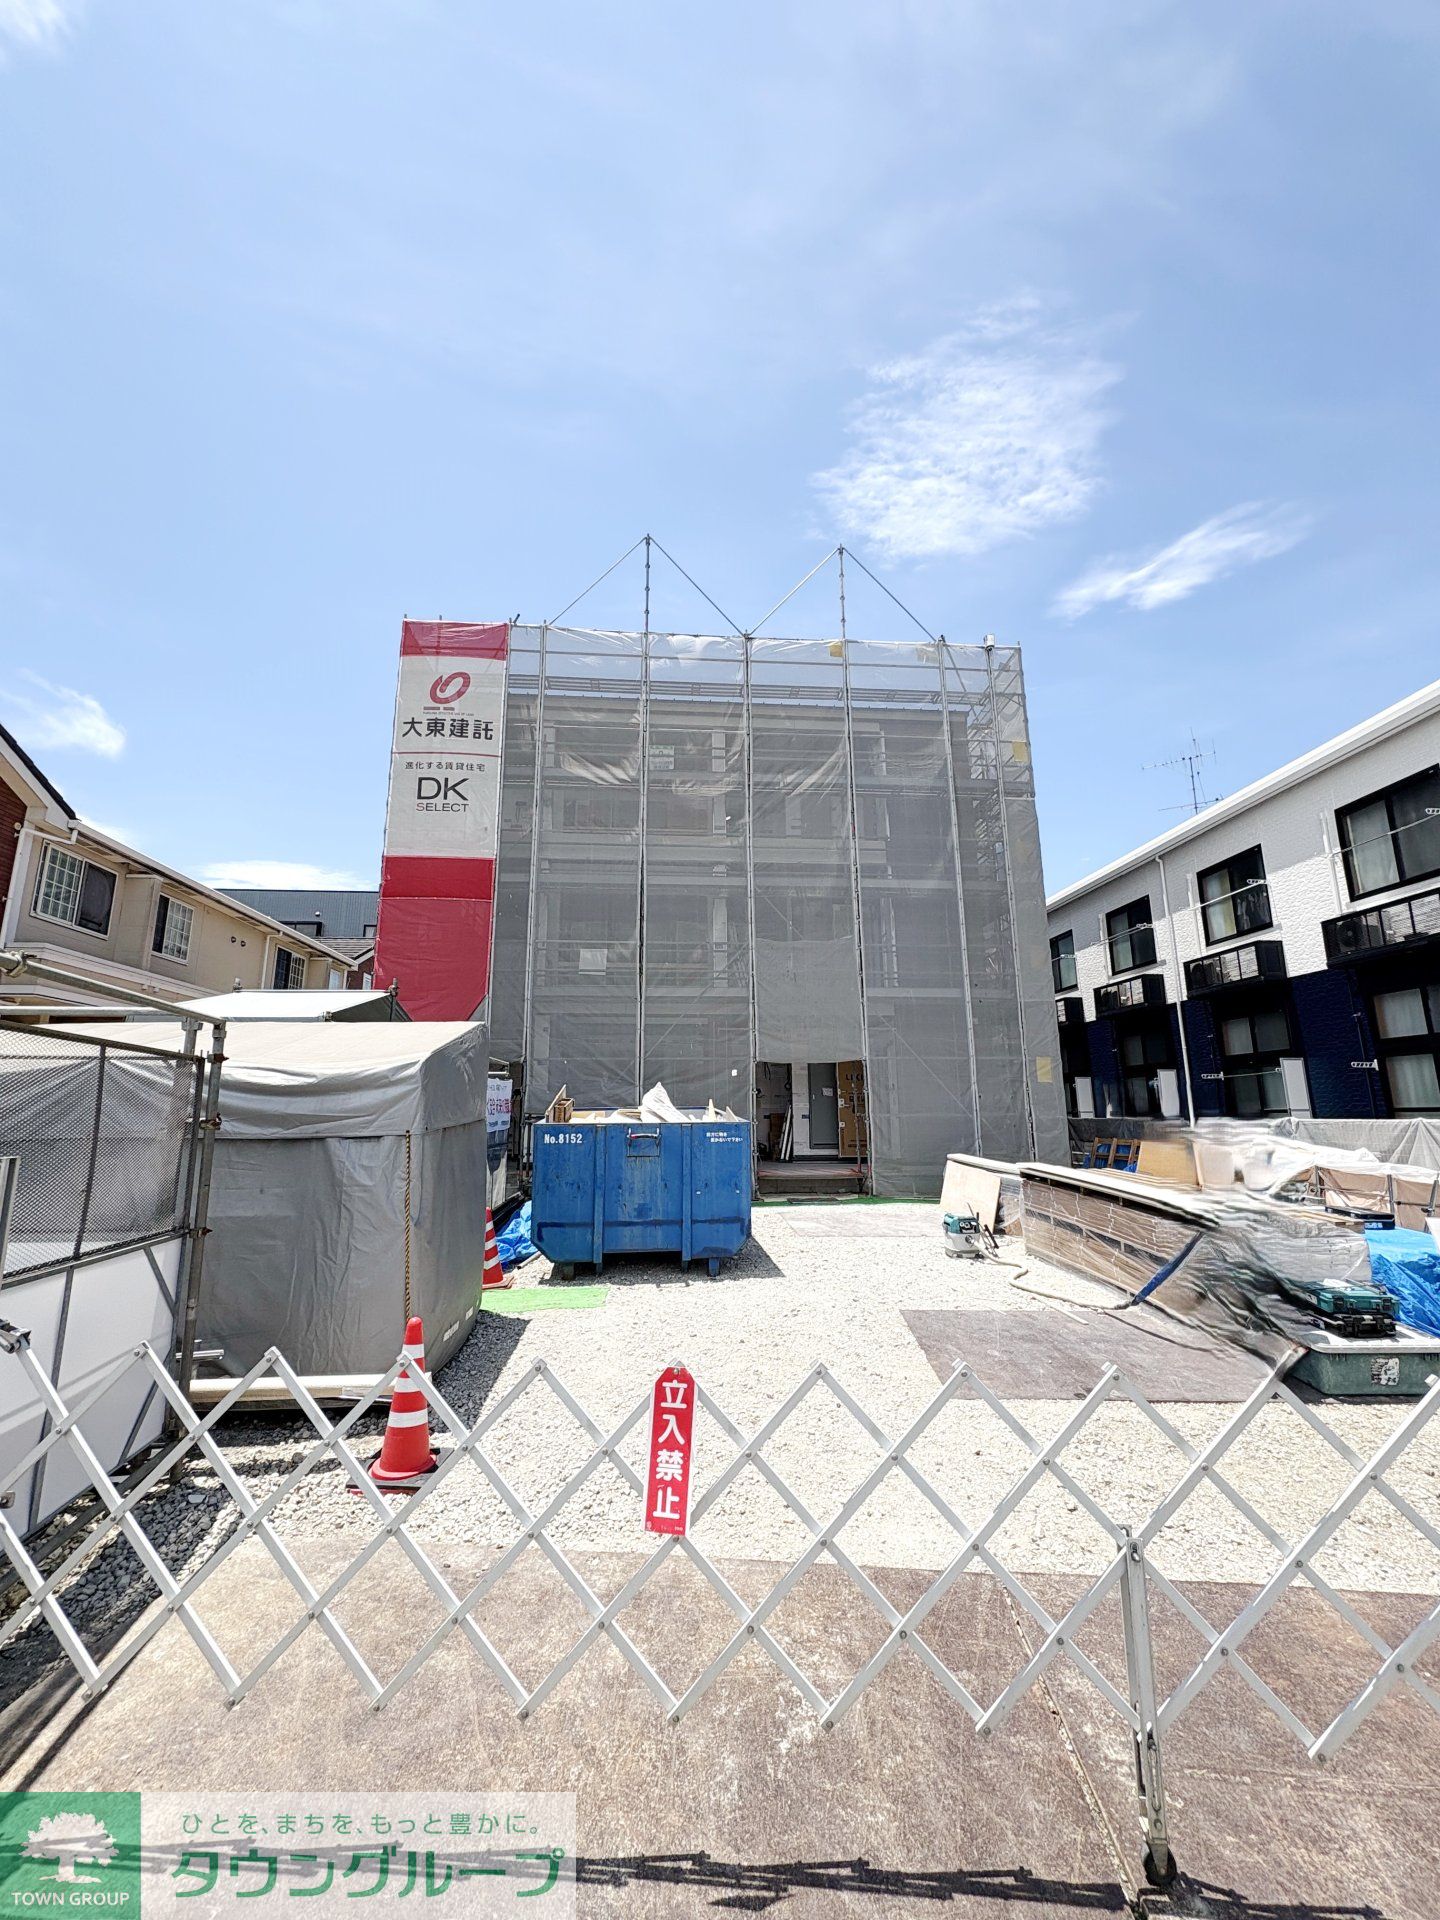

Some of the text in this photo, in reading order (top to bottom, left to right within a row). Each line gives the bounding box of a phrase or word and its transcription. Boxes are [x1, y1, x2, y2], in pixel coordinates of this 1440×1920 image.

[402, 717, 494, 740] 大東建託
[404, 761, 486, 772] 進化する賃貸住宅
[417, 777, 470, 802] DK
[416, 802, 470, 812] SELECT
[544, 1133, 583, 1144] No.8152
[652, 1379, 688, 1520] 立入禁止
